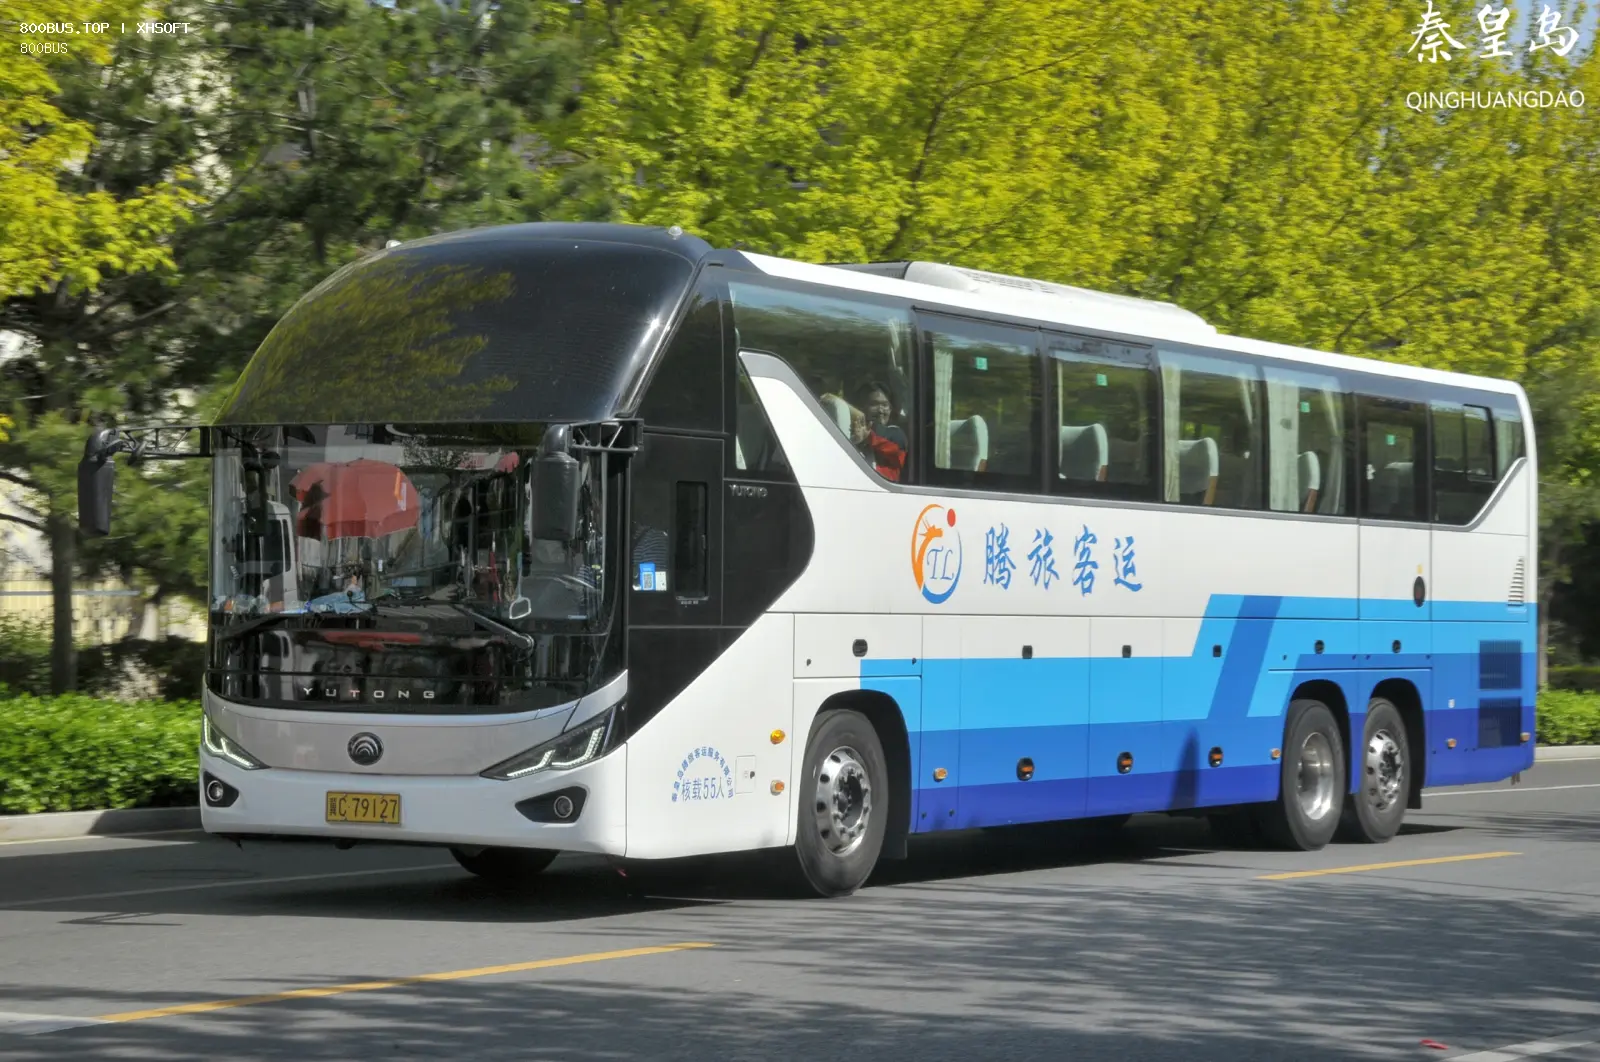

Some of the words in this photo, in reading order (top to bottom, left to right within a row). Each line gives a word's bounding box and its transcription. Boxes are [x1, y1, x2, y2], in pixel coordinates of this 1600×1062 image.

[926, 546, 955, 581] TL
[983, 523, 1143, 597] 腾旅客运
[303, 687, 435, 699] YUTONG
[680, 776, 725, 802] 核载55人
